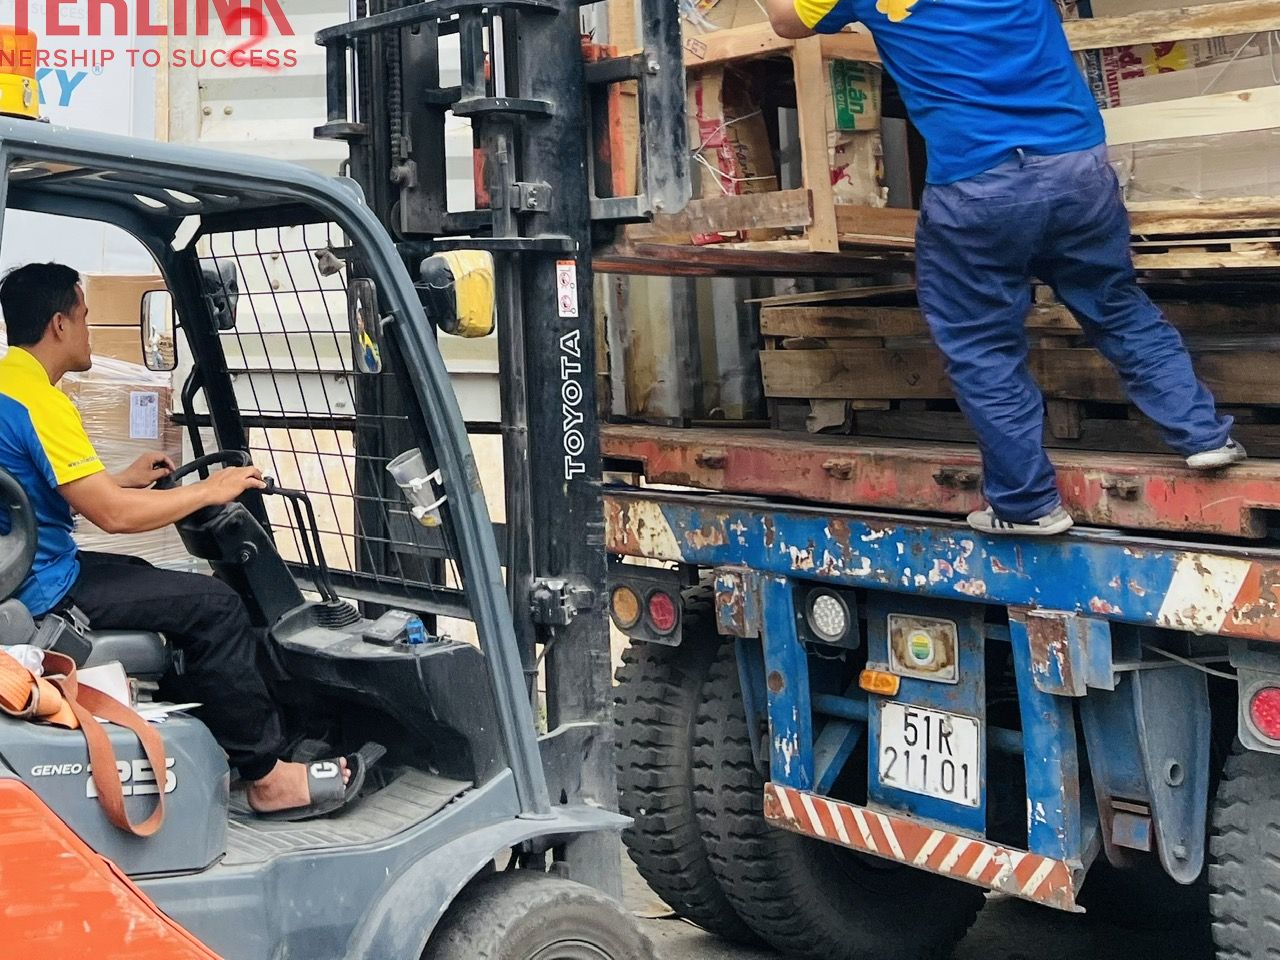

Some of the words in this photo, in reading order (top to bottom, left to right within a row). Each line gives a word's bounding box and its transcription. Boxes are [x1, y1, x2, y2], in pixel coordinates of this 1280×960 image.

[560, 329, 586, 480] TOYOTA
[904, 711, 952, 756] 51R
[31, 763, 82, 777] GENEO
